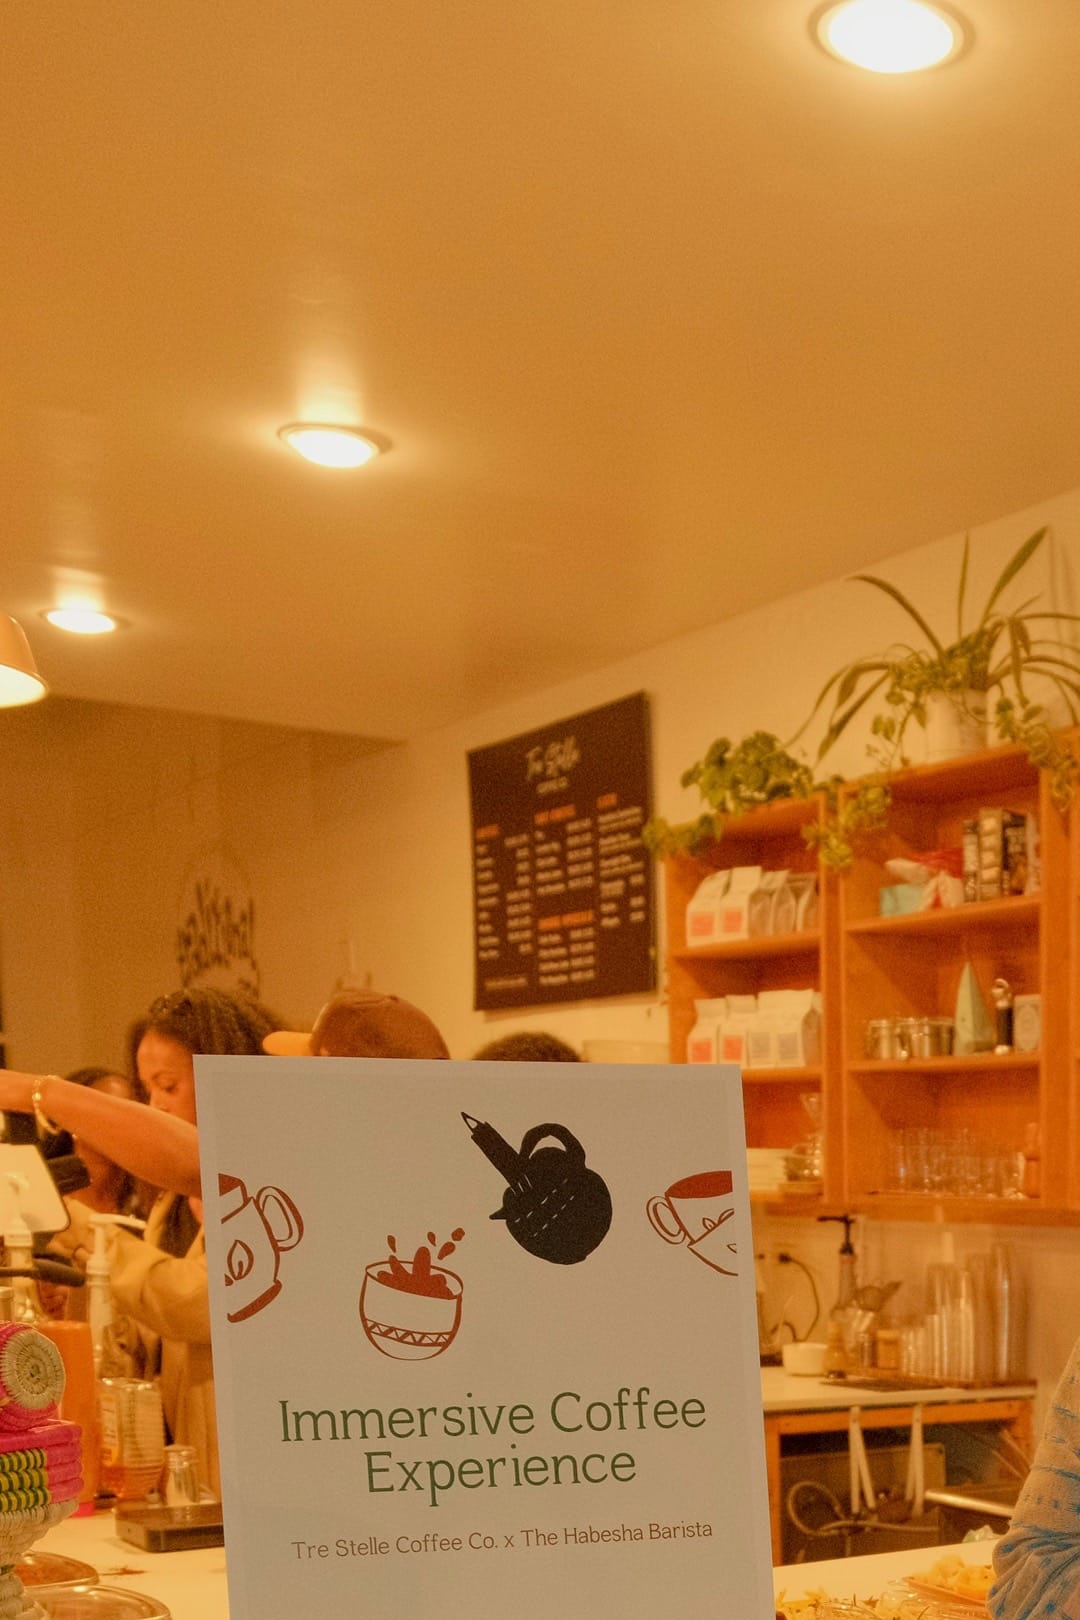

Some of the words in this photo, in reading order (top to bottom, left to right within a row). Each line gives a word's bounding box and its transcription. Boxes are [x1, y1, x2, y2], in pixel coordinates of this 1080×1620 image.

[279, 1392, 535, 1442] Immersive
[550, 1386, 706, 1433] Coffee
[363, 1443, 637, 1507] Experience
[291, 1541, 329, 1559] Tre
[335, 1536, 390, 1558] Stelle
[396, 1533, 463, 1554] Coffee
[468, 1532, 499, 1550] Co.
[504, 1535, 515, 1548] x
[520, 1528, 559, 1547] The
[564, 1524, 644, 1545] Habesha
[648, 1520, 713, 1540] Barista
